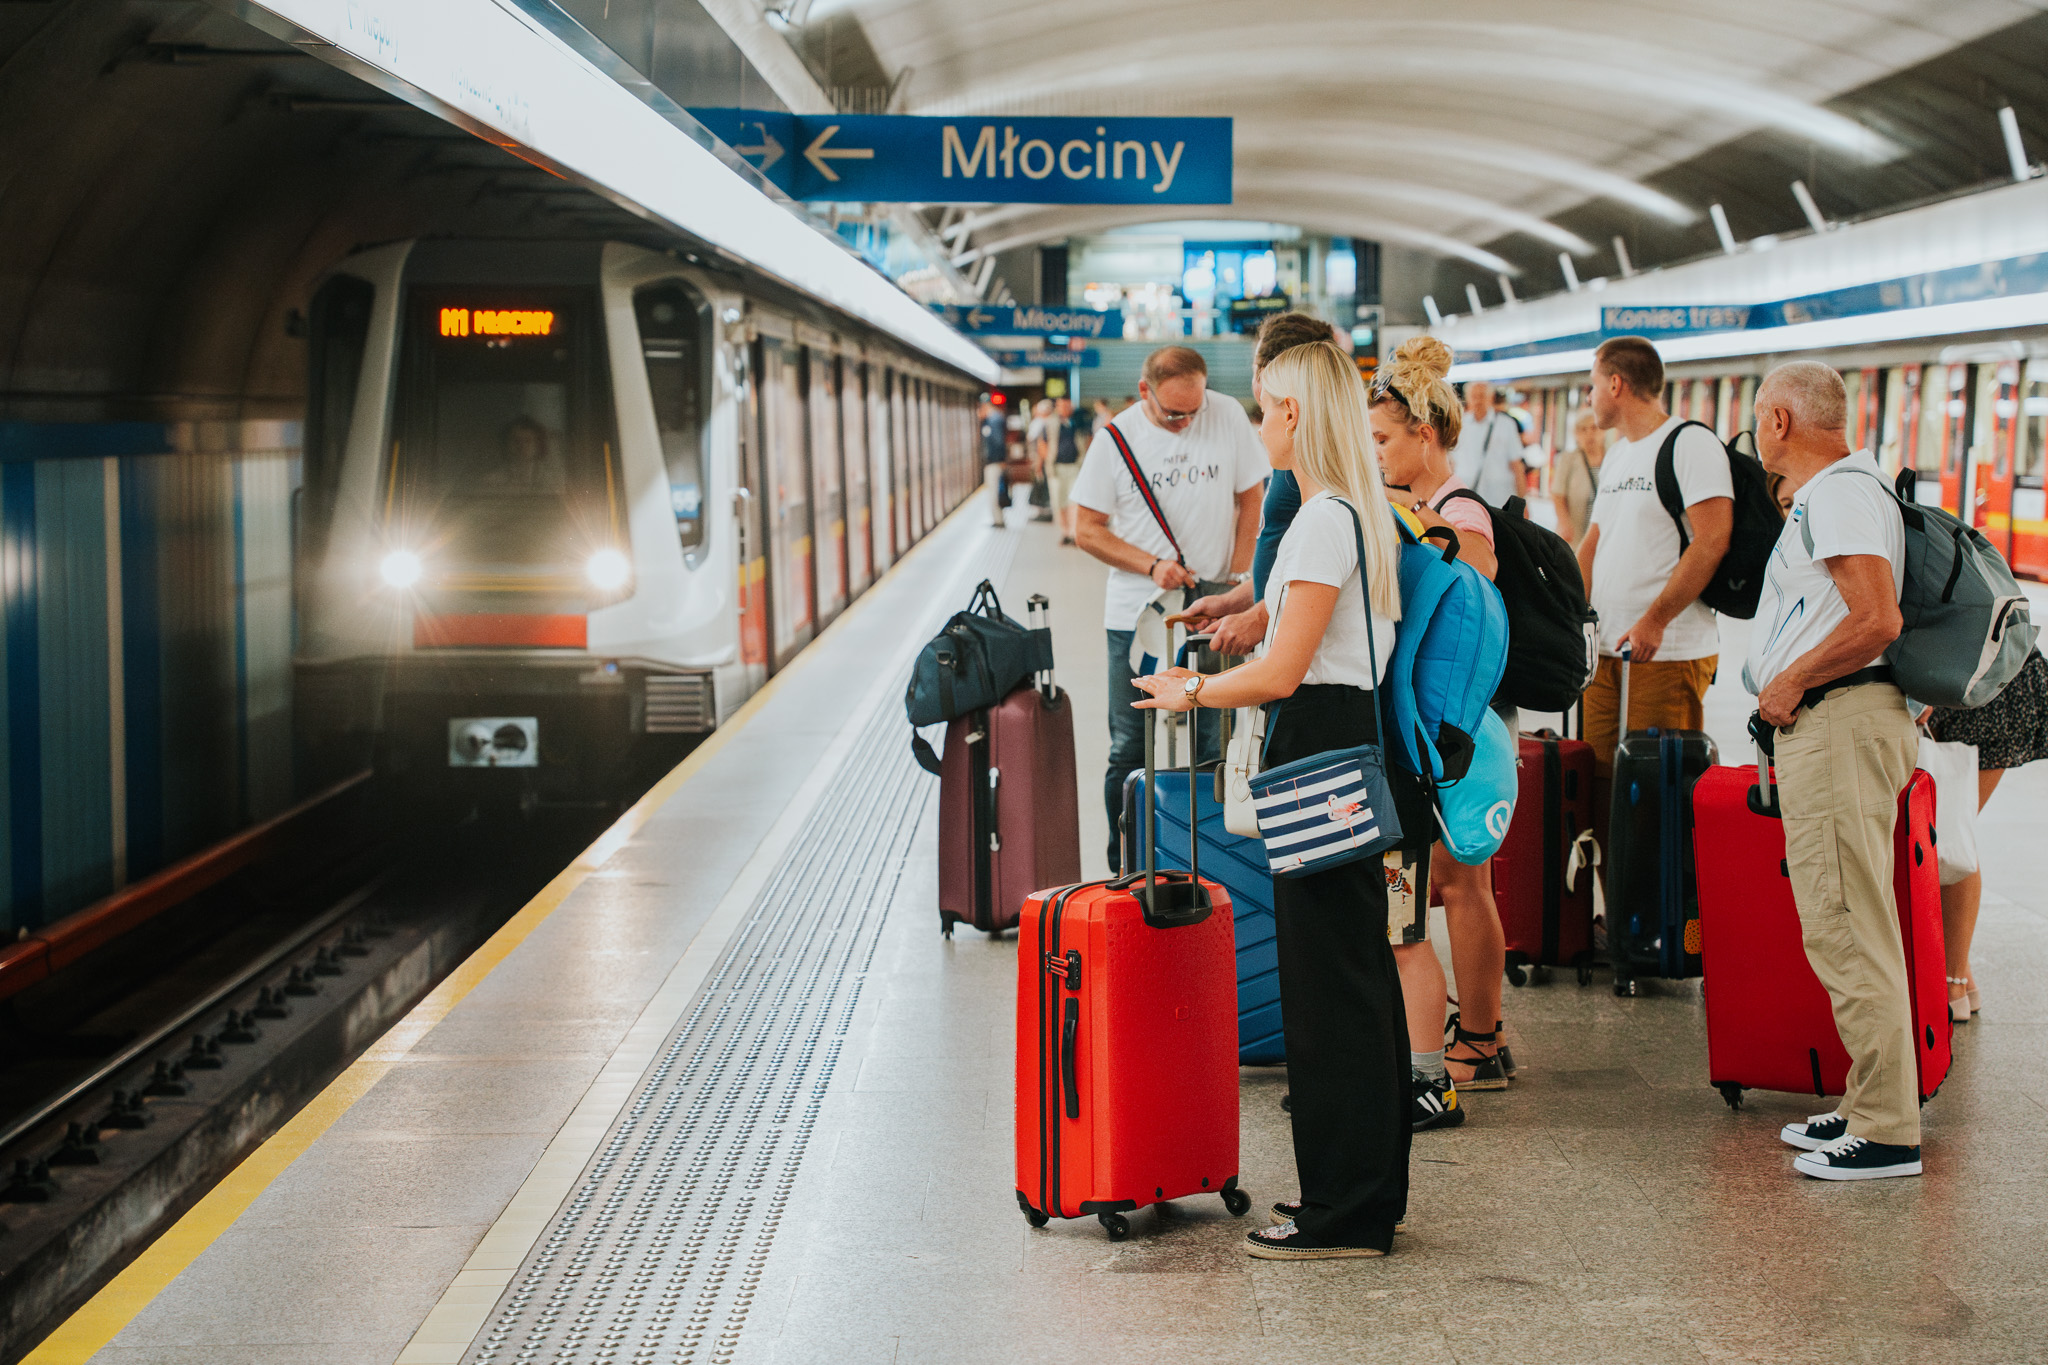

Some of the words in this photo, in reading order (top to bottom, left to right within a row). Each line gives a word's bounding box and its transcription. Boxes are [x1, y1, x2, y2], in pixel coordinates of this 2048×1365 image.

[941, 125, 1186, 194] Młociny
[1012, 307, 1105, 337] Młociny
[1604, 307, 1687, 329] Koniec
[1689, 306, 1750, 331] trasy
